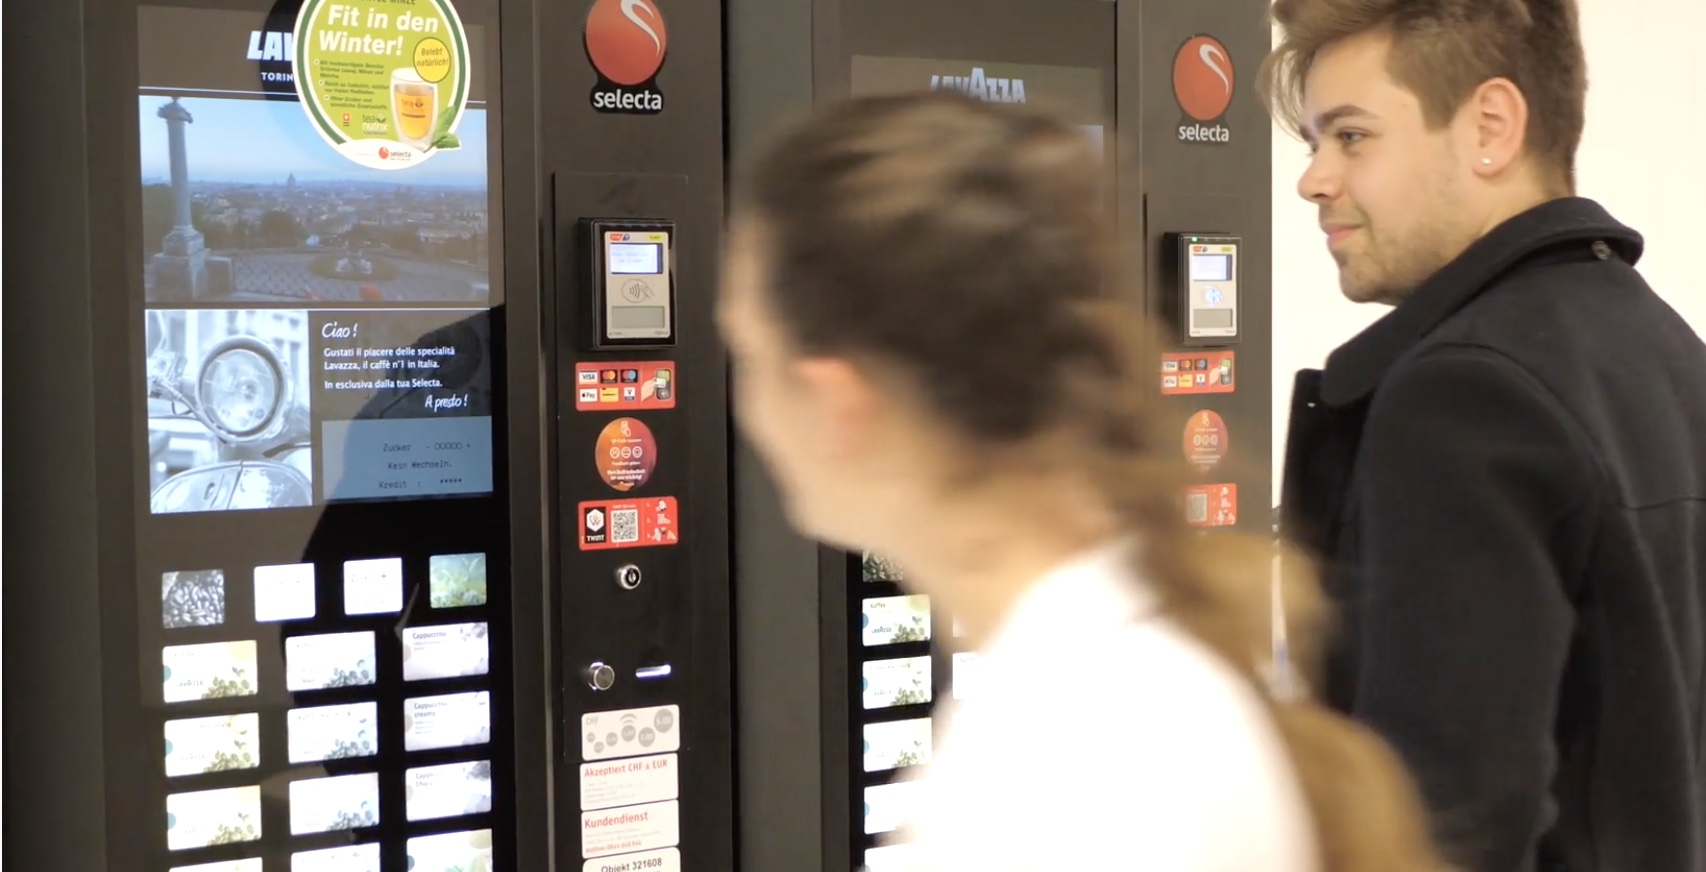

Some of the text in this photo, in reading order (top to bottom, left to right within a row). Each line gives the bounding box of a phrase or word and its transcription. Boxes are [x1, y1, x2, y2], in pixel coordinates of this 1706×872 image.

[327, 4, 438, 33] Fit in den
[319, 30, 404, 56] Winter!
[421, 48, 442, 57] Belebt
[416, 58, 448, 68] natürlich!
[260, 72, 294, 82] TORIN
[594, 89, 662, 111] selecta
[362, 115, 376, 123] tea
[1178, 124, 1230, 142] selecta
[322, 321, 350, 338] Ciao
[324, 346, 455, 359] Gustati il piacere delle specialità
[324, 361, 361, 371] Lavazza,
[362, 360, 368, 369] il
[371, 360, 391, 370] caffè
[408, 360, 416, 369] in
[417, 359, 440, 368] Italia.
[324, 378, 443, 389] In esclusiva dalla tua Selecta.
[425, 395, 433, 408] A
[434, 396, 461, 413] presto
[382, 443, 412, 452] Zucker
[387, 460, 453, 469] Kein Wechseln.
[378, 481, 407, 489] Kredit
[413, 631, 446, 641] Cappuccino
[584, 764, 626, 778] Akzeptiert
[628, 762, 643, 772] CHF
[652, 759, 668, 769] EUR
[584, 812, 648, 829] Kundendienst
[600, 858, 663, 872] Objekt 321608
